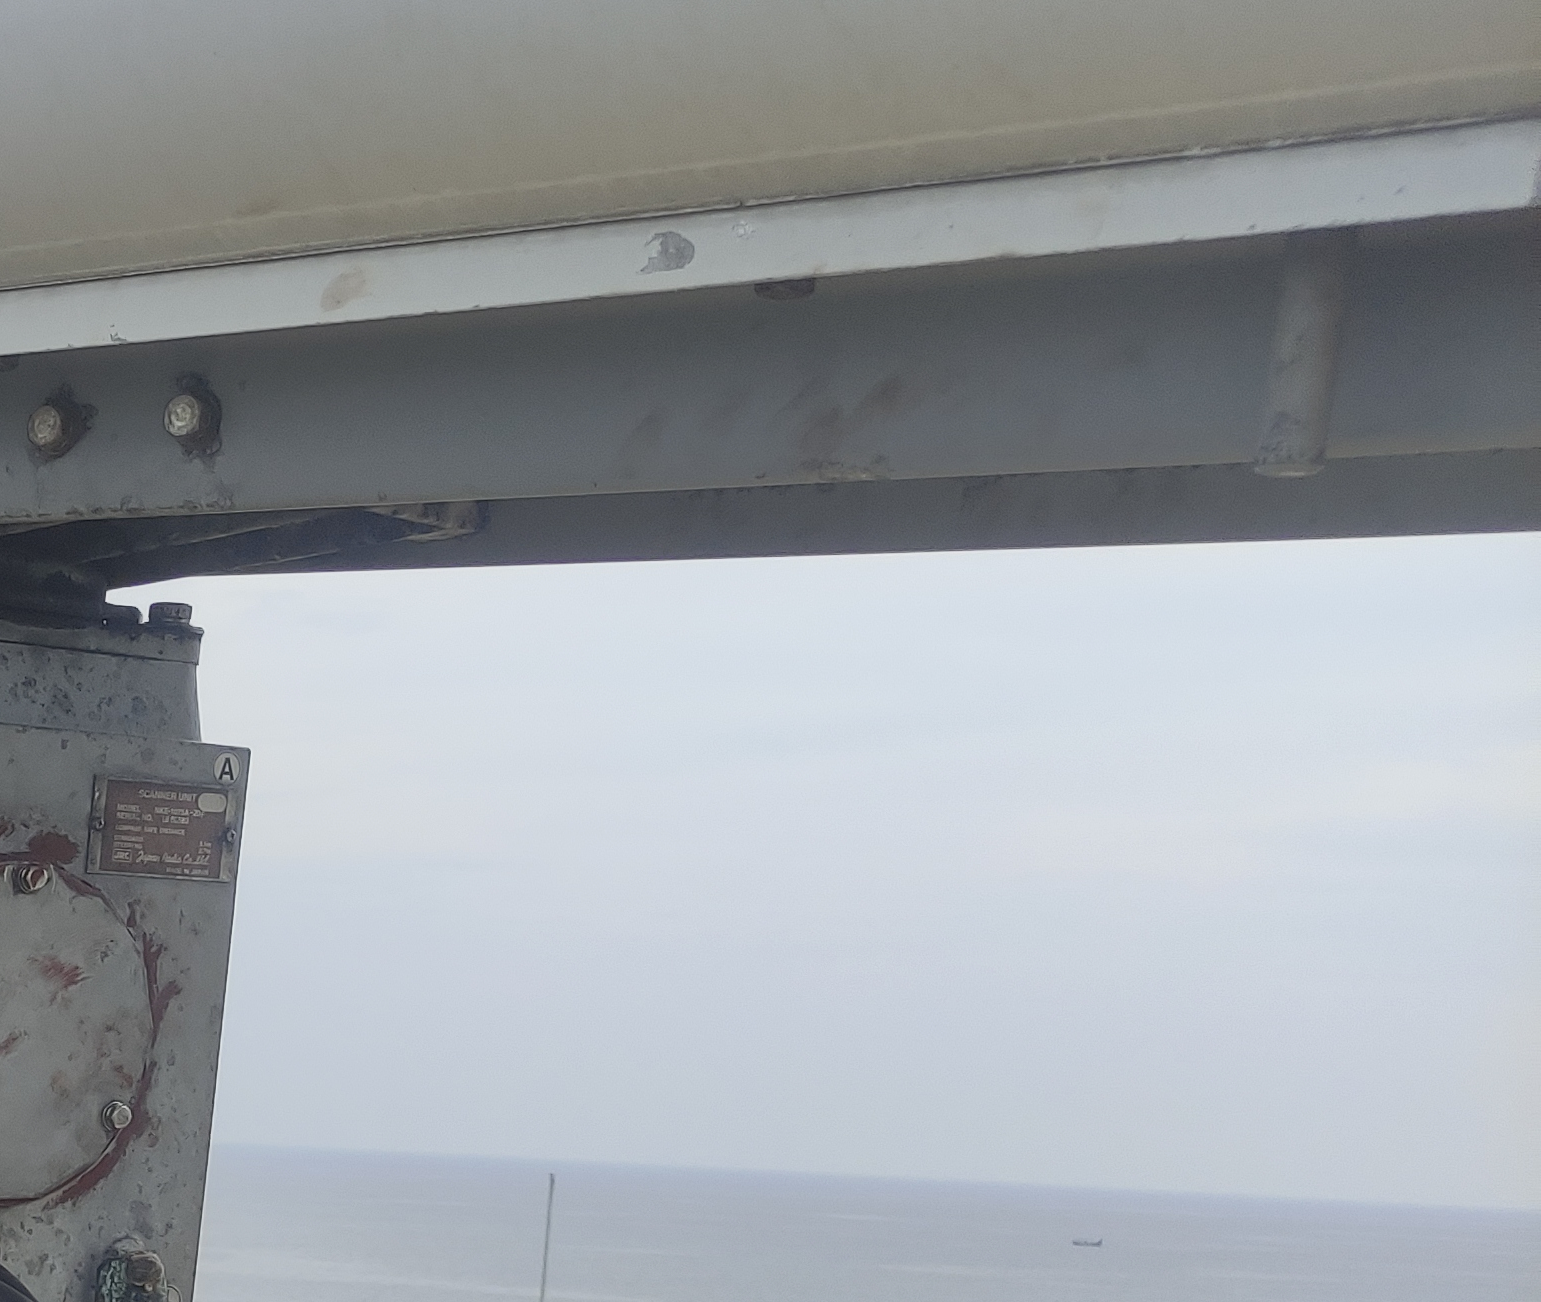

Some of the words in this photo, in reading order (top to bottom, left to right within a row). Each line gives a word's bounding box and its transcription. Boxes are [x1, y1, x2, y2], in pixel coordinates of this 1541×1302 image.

[218, 756, 235, 782] A
[138, 789, 177, 801] SCANNER
[178, 792, 197, 802] UNIT
